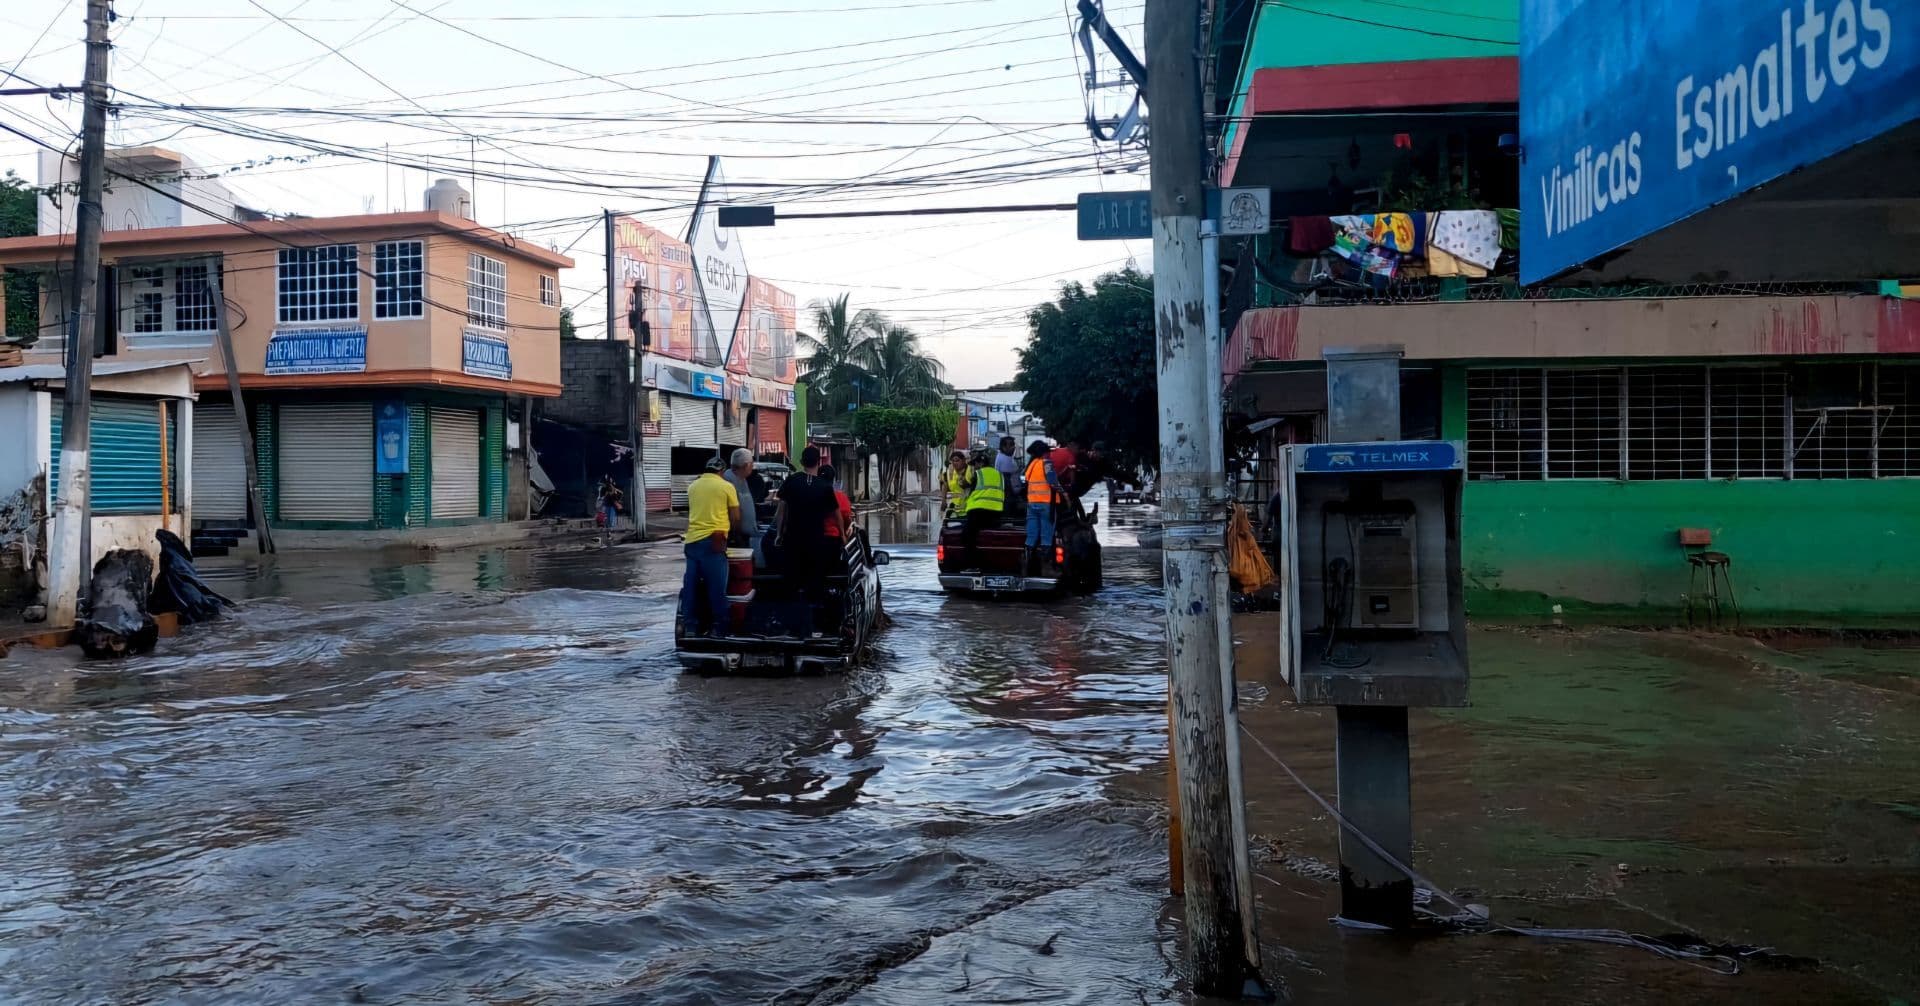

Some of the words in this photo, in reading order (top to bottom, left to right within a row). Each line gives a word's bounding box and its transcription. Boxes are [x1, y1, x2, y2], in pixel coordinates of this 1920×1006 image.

[1542, 131, 1642, 239] Vinilicas
[1676, 0, 1891, 170] Esmaltes
[706, 255, 737, 295] GERSA
[1359, 452, 1430, 463] TELMEX
